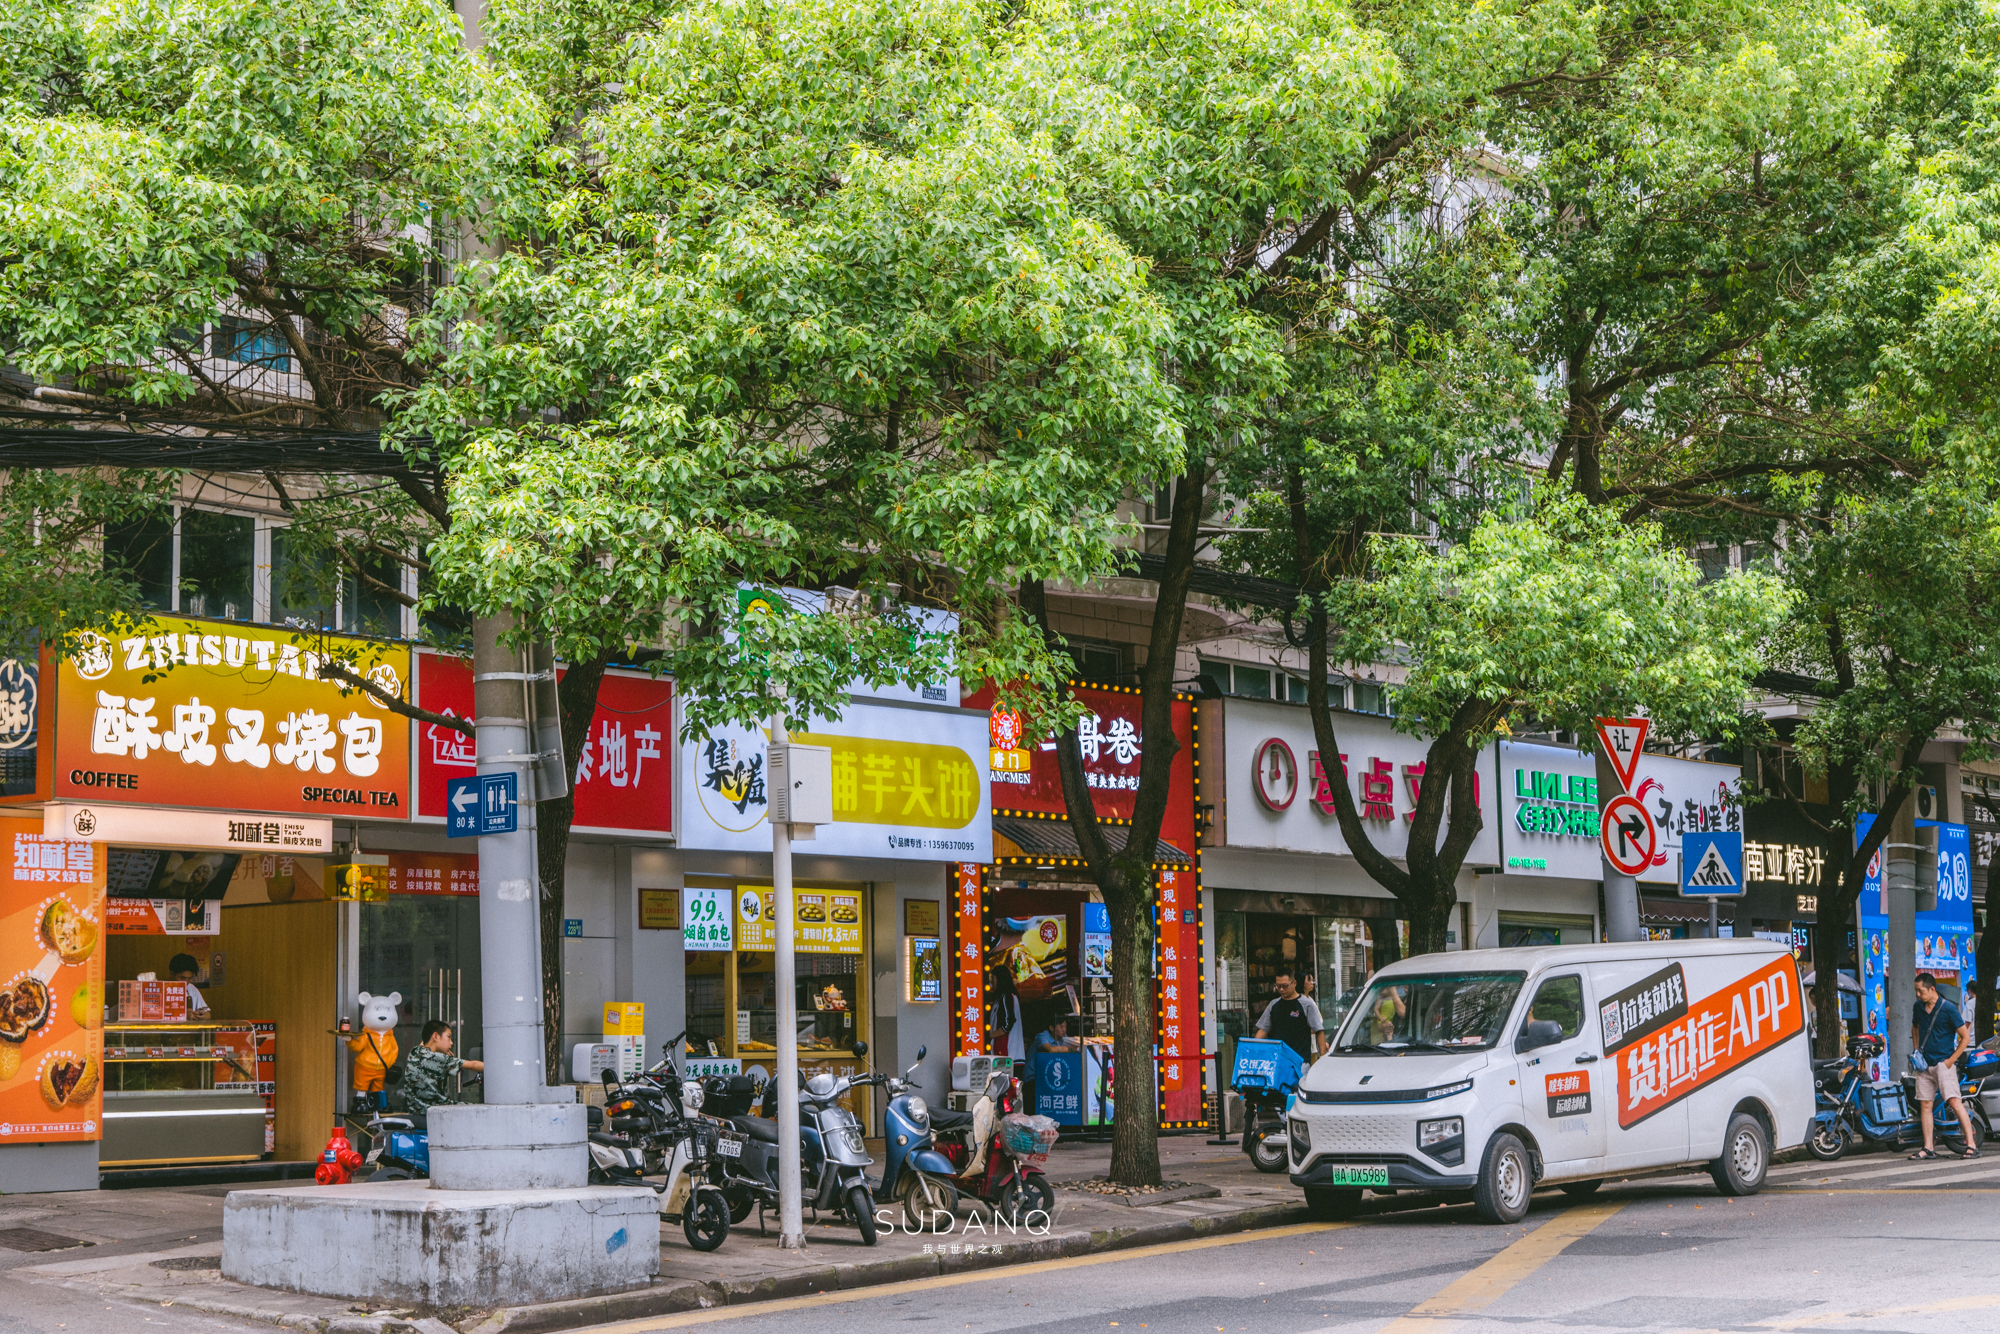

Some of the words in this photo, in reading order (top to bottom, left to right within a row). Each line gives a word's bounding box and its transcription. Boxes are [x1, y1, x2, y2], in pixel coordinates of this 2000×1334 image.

[92, 690, 382, 777] 酥皮叉烧包
[1613, 728, 1632, 752] 让
[993, 751, 1020, 770] 唐门
[70, 769, 139, 790] COFFEE
[1084, 771, 1140, 791] 街美食必吃
[302, 786, 367, 805] SPECIAL
[369, 790, 399, 807] TEA
[227, 819, 281, 845] 知酥堂
[284, 823, 305, 831] ZHISU
[456, 816, 466, 828] 80
[283, 836, 322, 847] 酥皮叉烧包
[14, 840, 93, 871] 知酥堂
[1739, 840, 1825, 887] 南亚榨汁
[13, 868, 93, 884] 酥皮叉烧包
[406, 867, 442, 879] 房屋租赁
[450, 869, 480, 880] 房产咨
[406, 880, 443, 891] 按揭贷款
[450, 881, 480, 892] 楼盘代
[1621, 972, 1684, 1034] 拉货就找
[1163, 946, 1181, 1081] 低脂健康好味道
[1548, 1075, 1580, 1093] 啥车都有
[1555, 1095, 1587, 1114] 运啥都快
